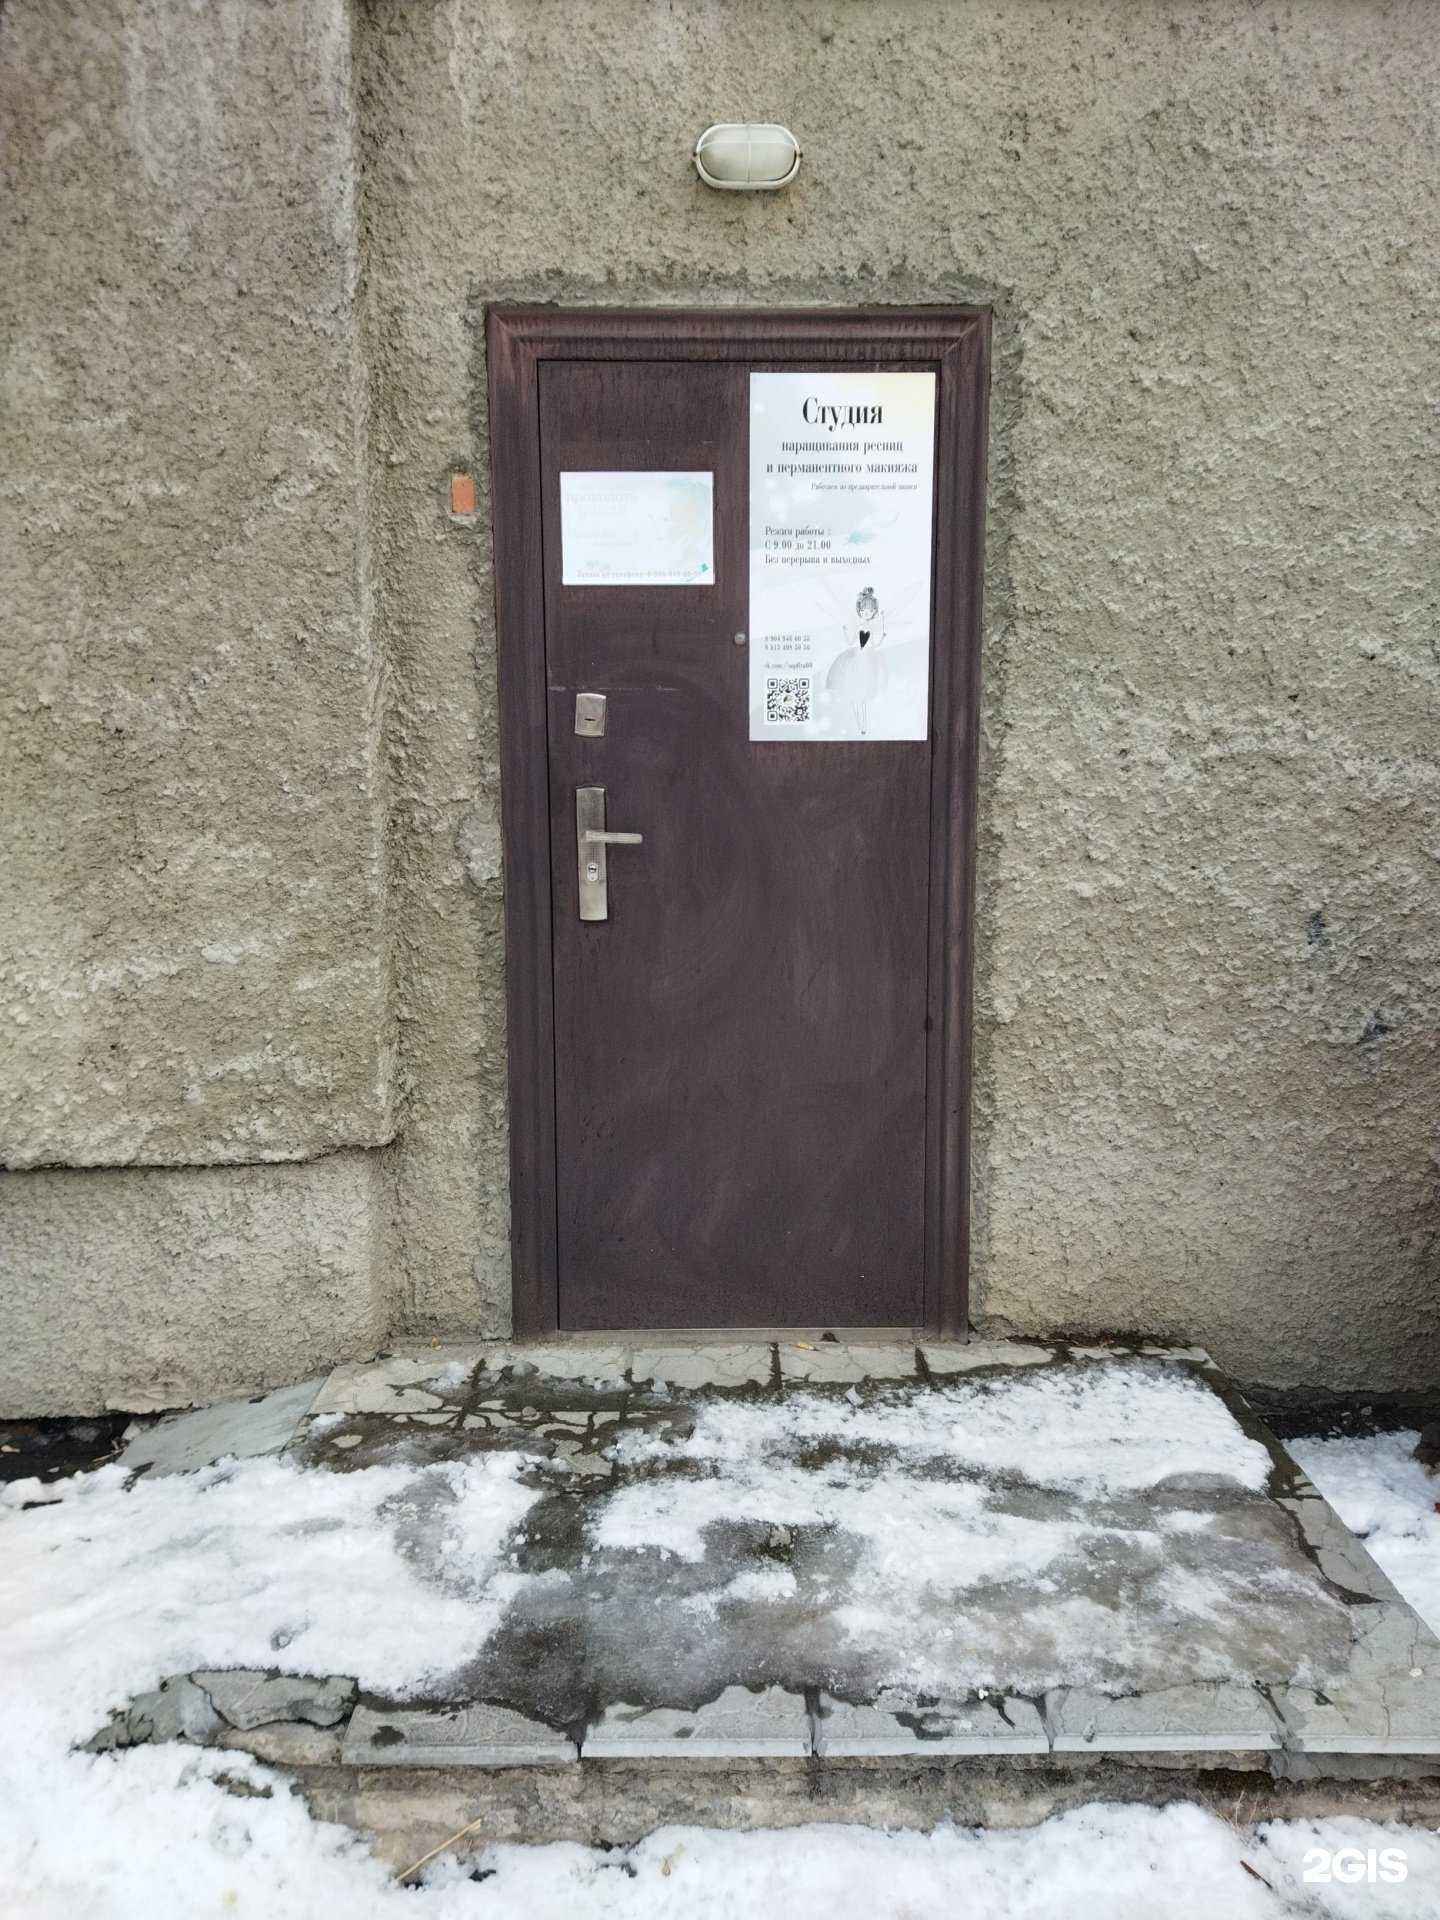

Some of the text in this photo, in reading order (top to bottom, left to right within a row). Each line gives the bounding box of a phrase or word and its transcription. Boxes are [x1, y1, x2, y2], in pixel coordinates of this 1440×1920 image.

[802, 396, 883, 432] Студия
[781, 441, 904, 455] наращивания ресниц
[766, 463, 918, 477] и перманентного макияжа
[765, 526, 792, 536] Режим
[765, 554, 778, 564] Без
[781, 556, 821, 566] перерыва
